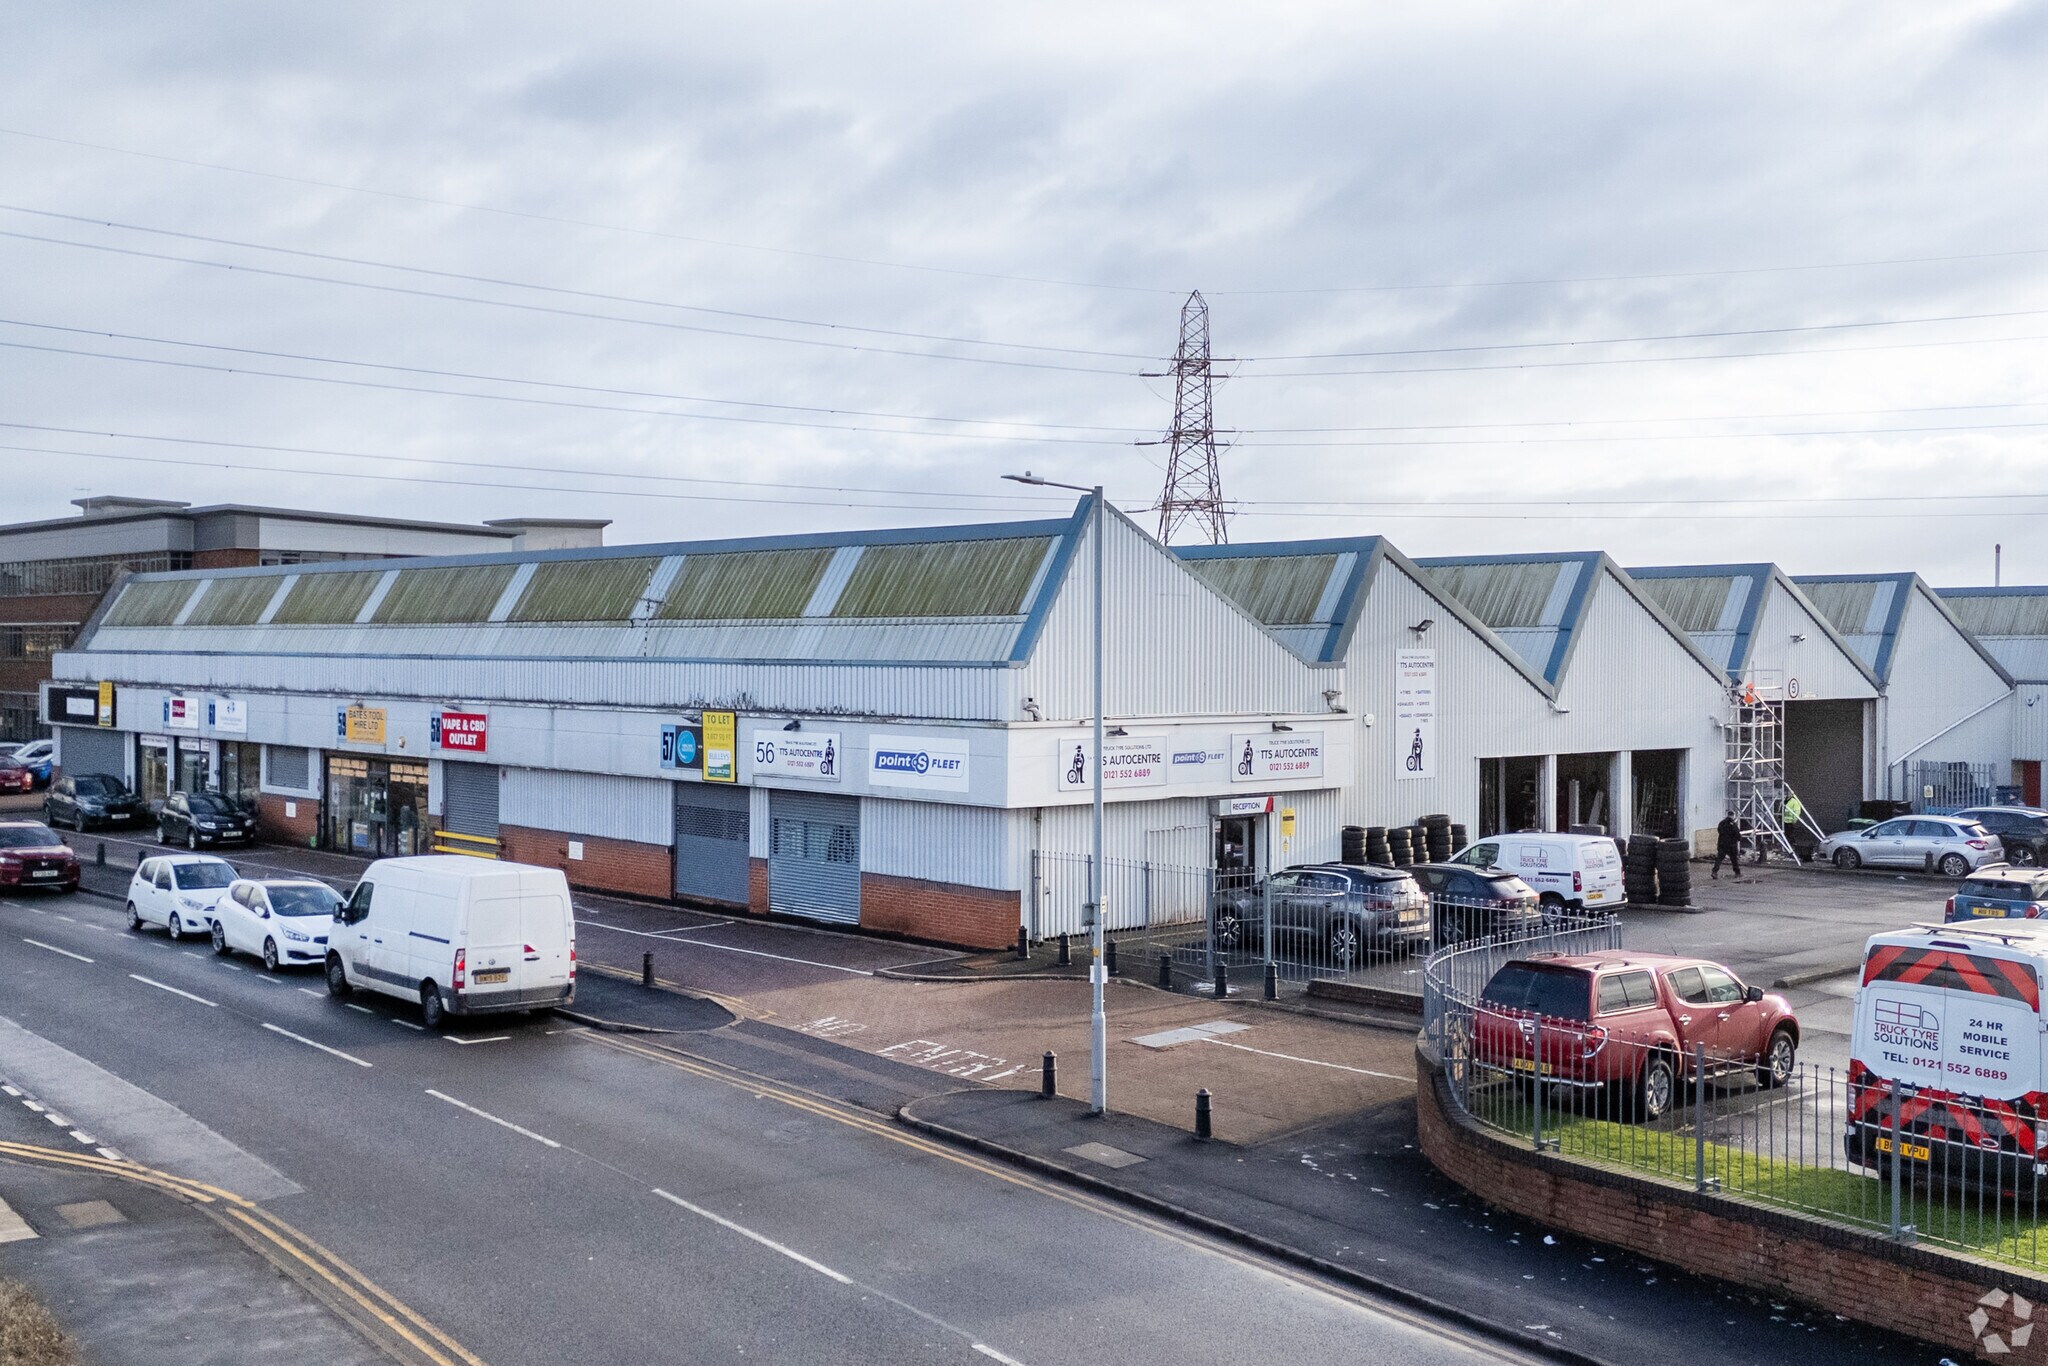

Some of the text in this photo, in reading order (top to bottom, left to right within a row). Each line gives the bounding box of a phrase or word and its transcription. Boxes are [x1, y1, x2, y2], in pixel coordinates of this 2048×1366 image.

[369, 711, 384, 721] TOOL
[706, 715, 730, 725] TO LET
[338, 712, 346, 736] 59
[354, 720, 379, 730] HIRE LTD
[431, 718, 441, 742] 58
[442, 718, 486, 732] VAPE & CBD
[448, 732, 478, 746] OUTLET
[663, 732, 674, 761] 57
[756, 742, 775, 763] 56
[779, 747, 823, 758] TTS AUTOCENTRE
[1261, 747, 1319, 759] TTS AUTOCENTRE
[879, 754, 960, 771] point S FLEET
[1109, 753, 1161, 765] AUTOCENTRE
[1174, 754, 1196, 763] point
[1269, 763, 1281, 771] 0121
[1295, 761, 1310, 769] 6889
[1103, 768, 1151, 779] 0121 552 6889
[1232, 801, 1260, 811] RECEPTION
[1969, 1018, 2003, 1031] 24 HR
[1874, 1022, 1939, 1042] TRUCK TYRE
[1963, 1031, 2008, 1046] MOBILE
[1873, 1032, 1939, 1051] SOLUTIONS
[1959, 1045, 2010, 1061] SERVICE
[1882, 1051, 2008, 1081] TEL: 0121 552 6889
[1907, 1145, 1926, 1157] VPU
